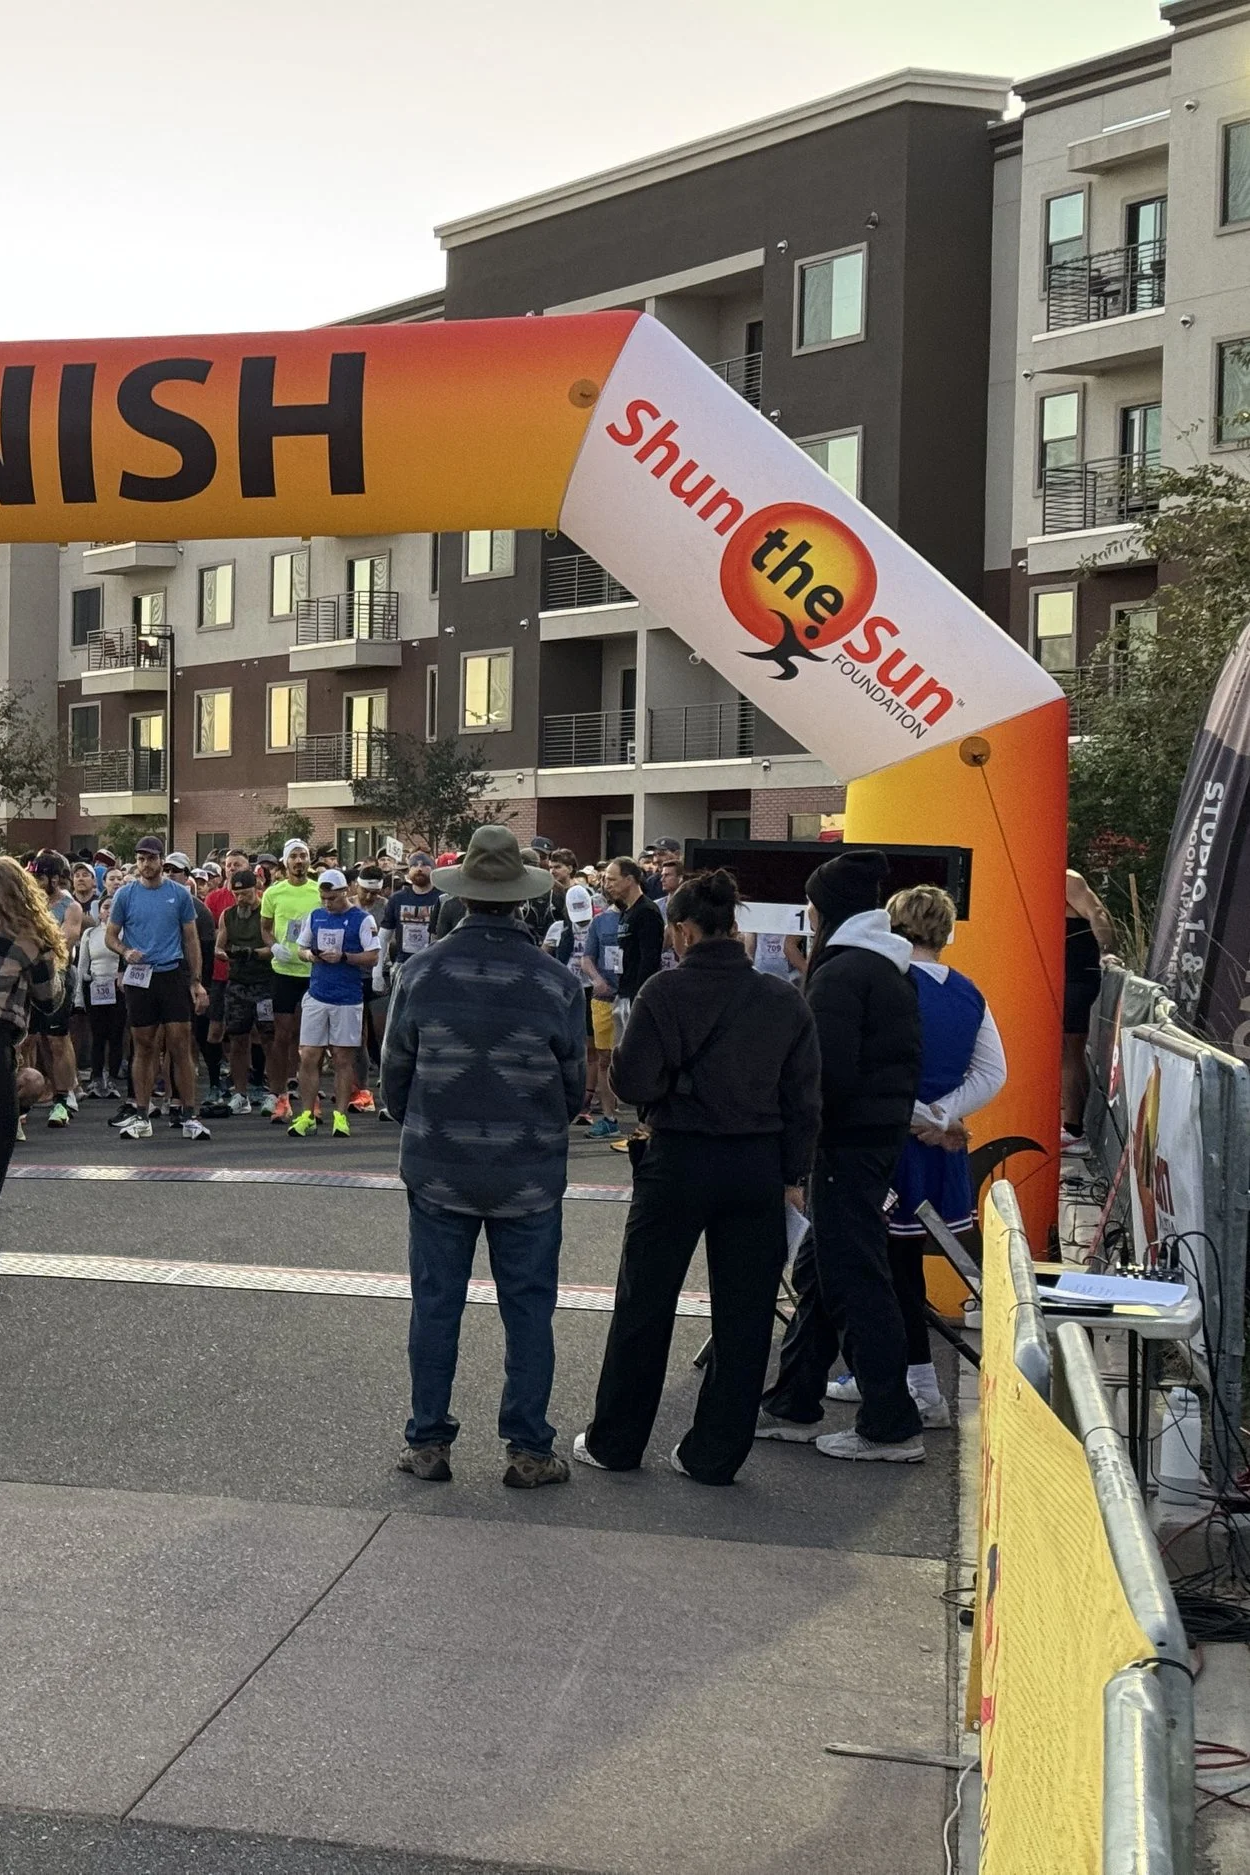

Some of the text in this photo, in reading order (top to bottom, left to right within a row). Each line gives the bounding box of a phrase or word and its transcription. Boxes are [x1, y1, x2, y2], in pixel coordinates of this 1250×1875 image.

[606, 399, 955, 726] Shun the Sun
[831, 653, 928, 740] FOUNDATION
[767, 944, 781, 953] 709
